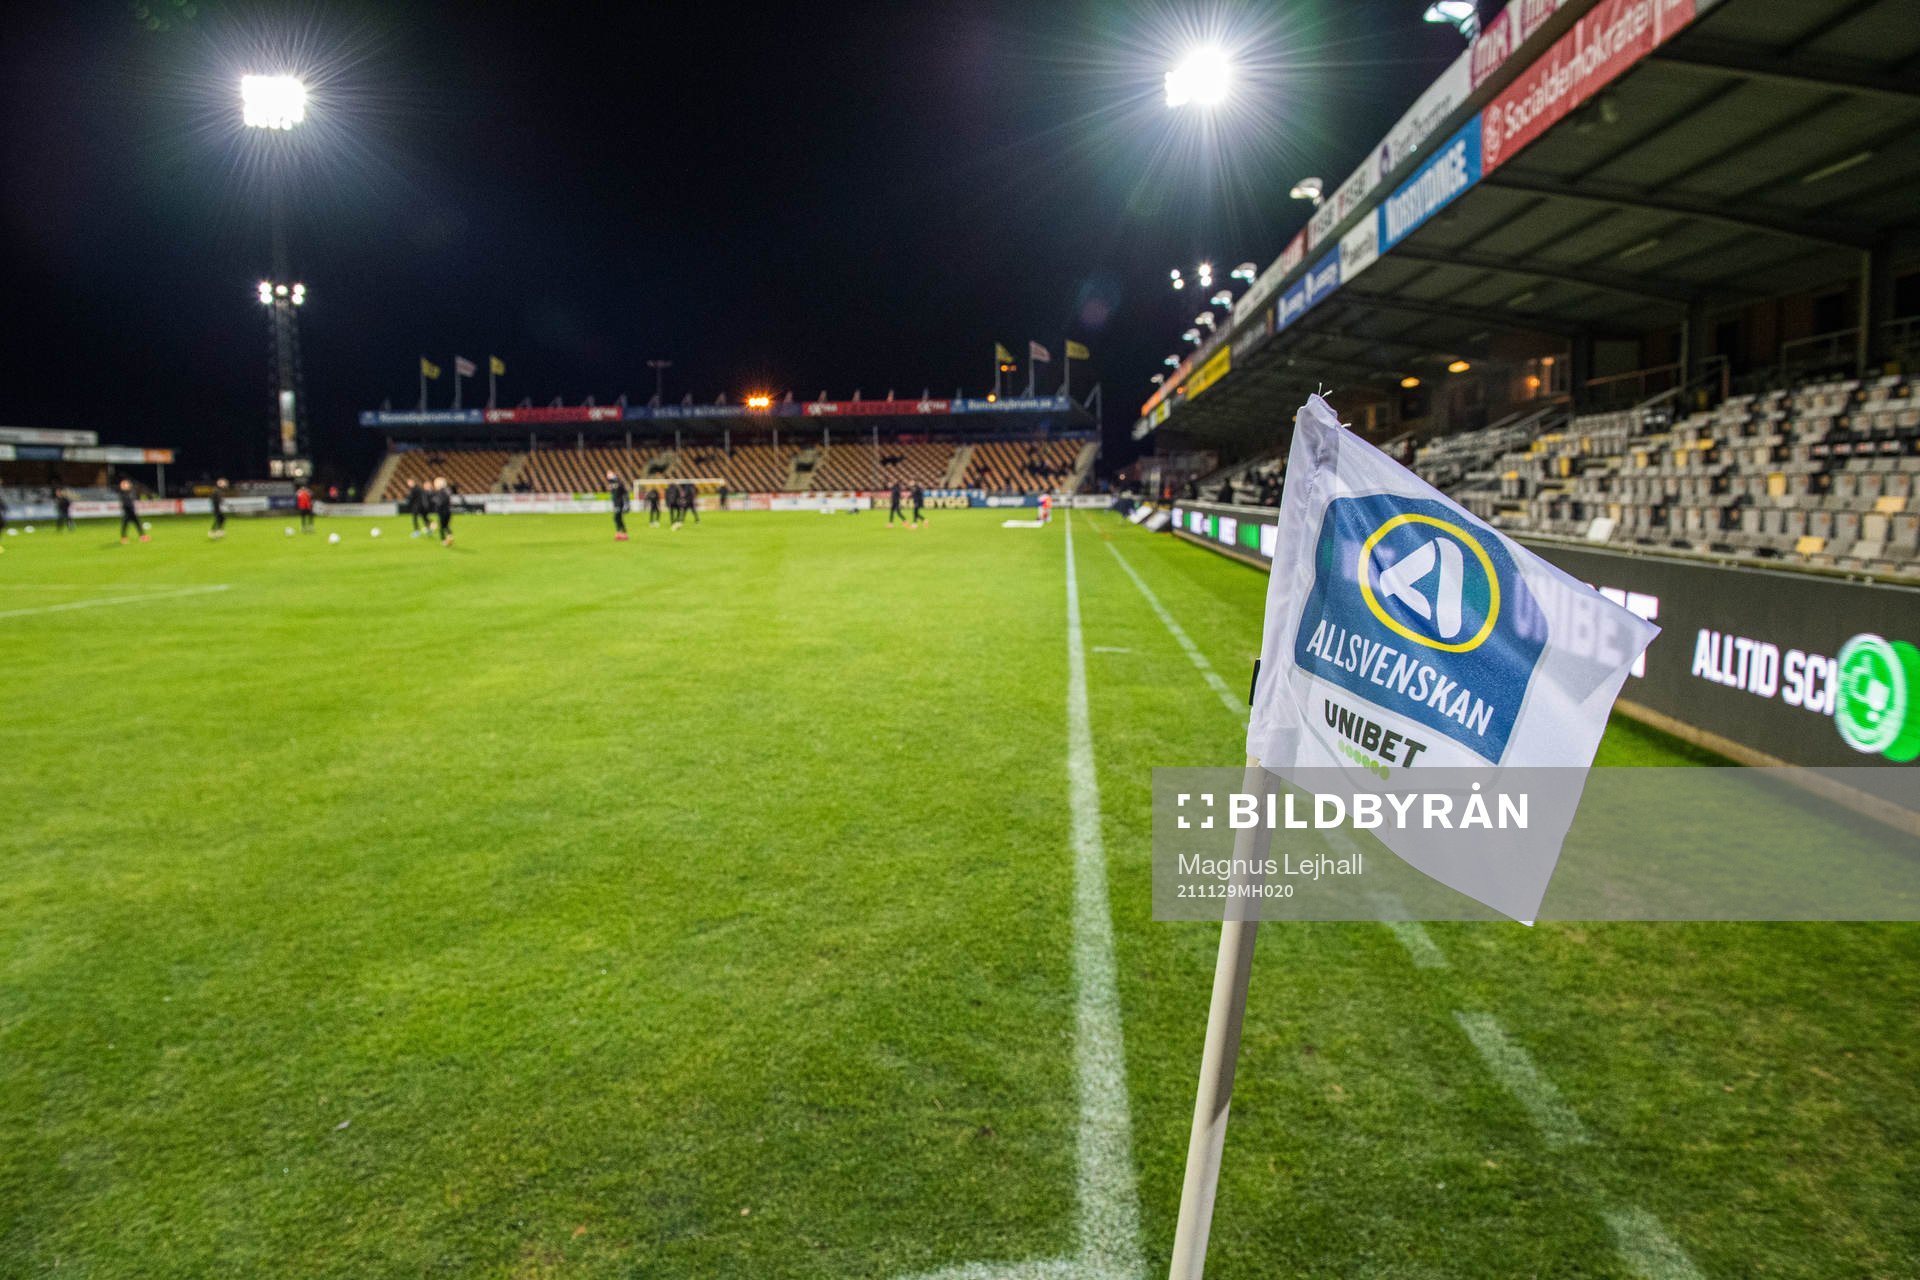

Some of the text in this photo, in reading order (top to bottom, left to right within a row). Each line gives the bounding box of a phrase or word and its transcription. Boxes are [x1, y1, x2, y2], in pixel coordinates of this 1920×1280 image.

[1307, 619, 1494, 737] ALLSVENSKAN
[1691, 628, 1780, 698] ALLTID
[1324, 698, 1427, 770] UNIBET
